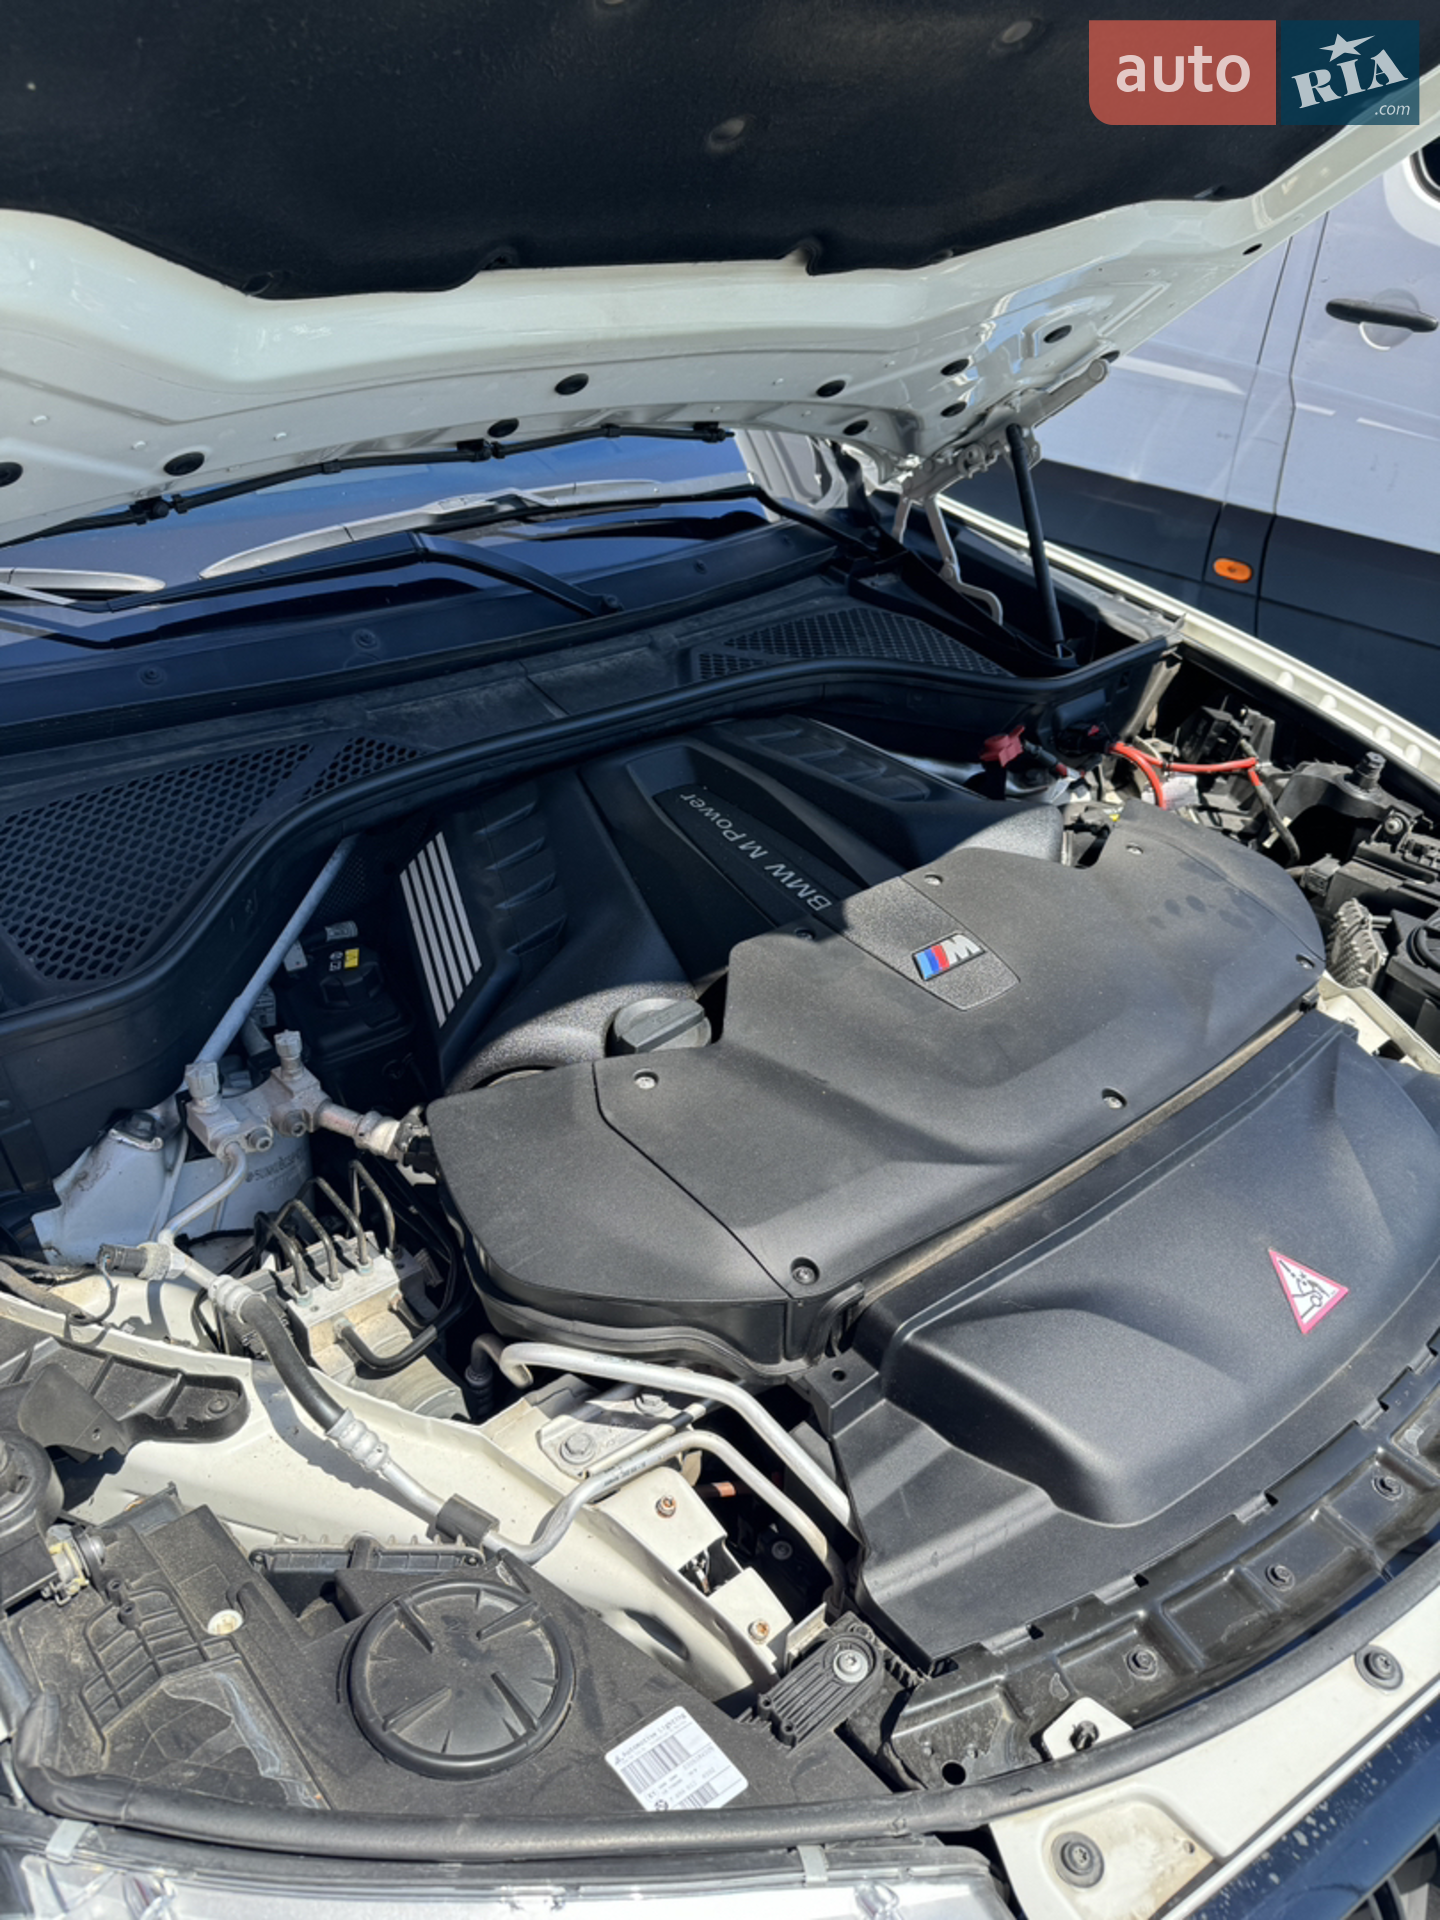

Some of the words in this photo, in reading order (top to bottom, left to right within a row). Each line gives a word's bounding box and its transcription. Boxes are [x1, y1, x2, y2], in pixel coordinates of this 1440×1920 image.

[680, 793, 747, 842] Power
[738, 840, 768, 860] M
[764, 863, 833, 911] BMW
